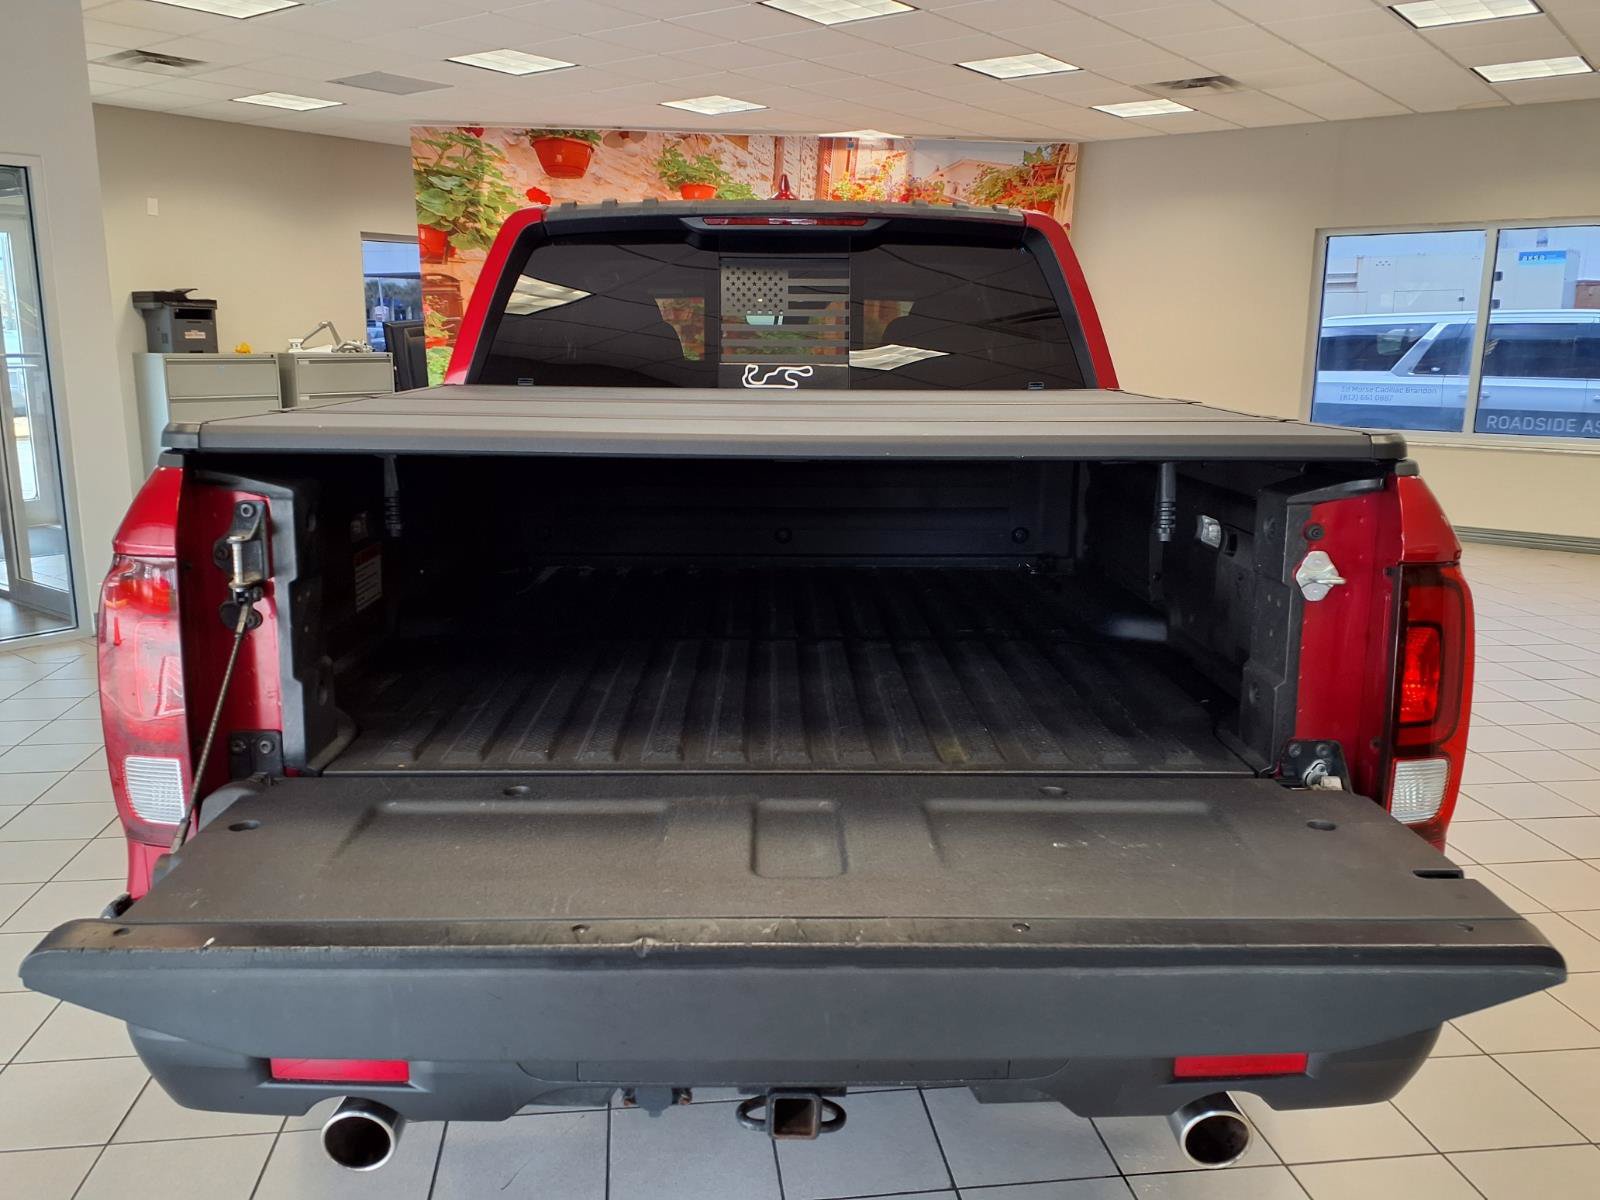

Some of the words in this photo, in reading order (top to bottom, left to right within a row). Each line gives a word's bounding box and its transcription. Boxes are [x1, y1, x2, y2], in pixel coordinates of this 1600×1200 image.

[1375, 385, 1403, 393] Cadillac
[1405, 386, 1436, 394] Brandon
[1486, 415, 1577, 432] ROADSIDE
